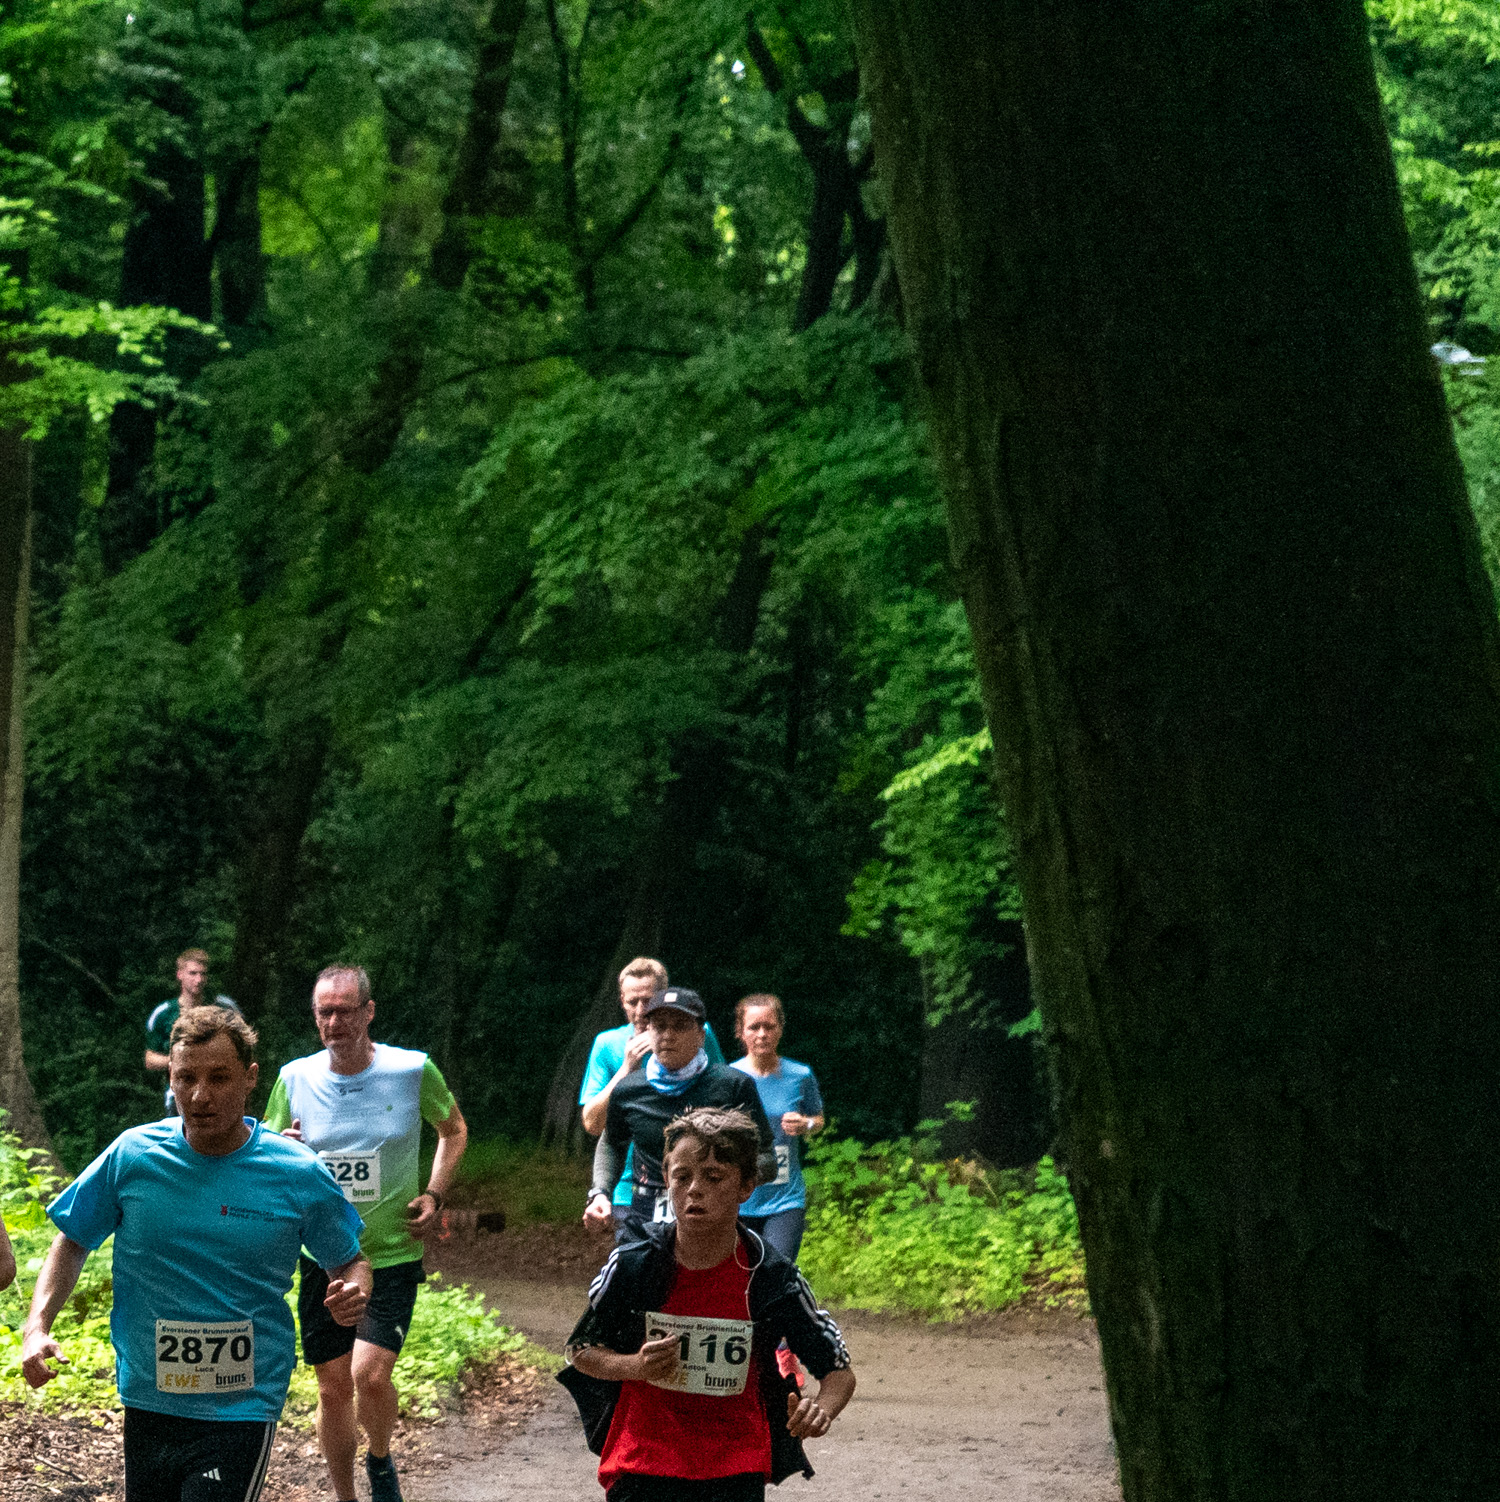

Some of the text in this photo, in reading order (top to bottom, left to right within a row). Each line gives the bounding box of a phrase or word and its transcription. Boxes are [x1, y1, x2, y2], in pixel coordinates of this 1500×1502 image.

[162, 1326, 249, 1334] Everstener Brunnenlauf
[697, 1323, 746, 1333] Brunnenlauf
[158, 1334, 252, 1365] 2870
[195, 1365, 214, 1373] Luca
[682, 1363, 707, 1372] Anton
[165, 1373, 200, 1388] EWE
[215, 1372, 246, 1386] bruns
[704, 1373, 738, 1388] bruns
